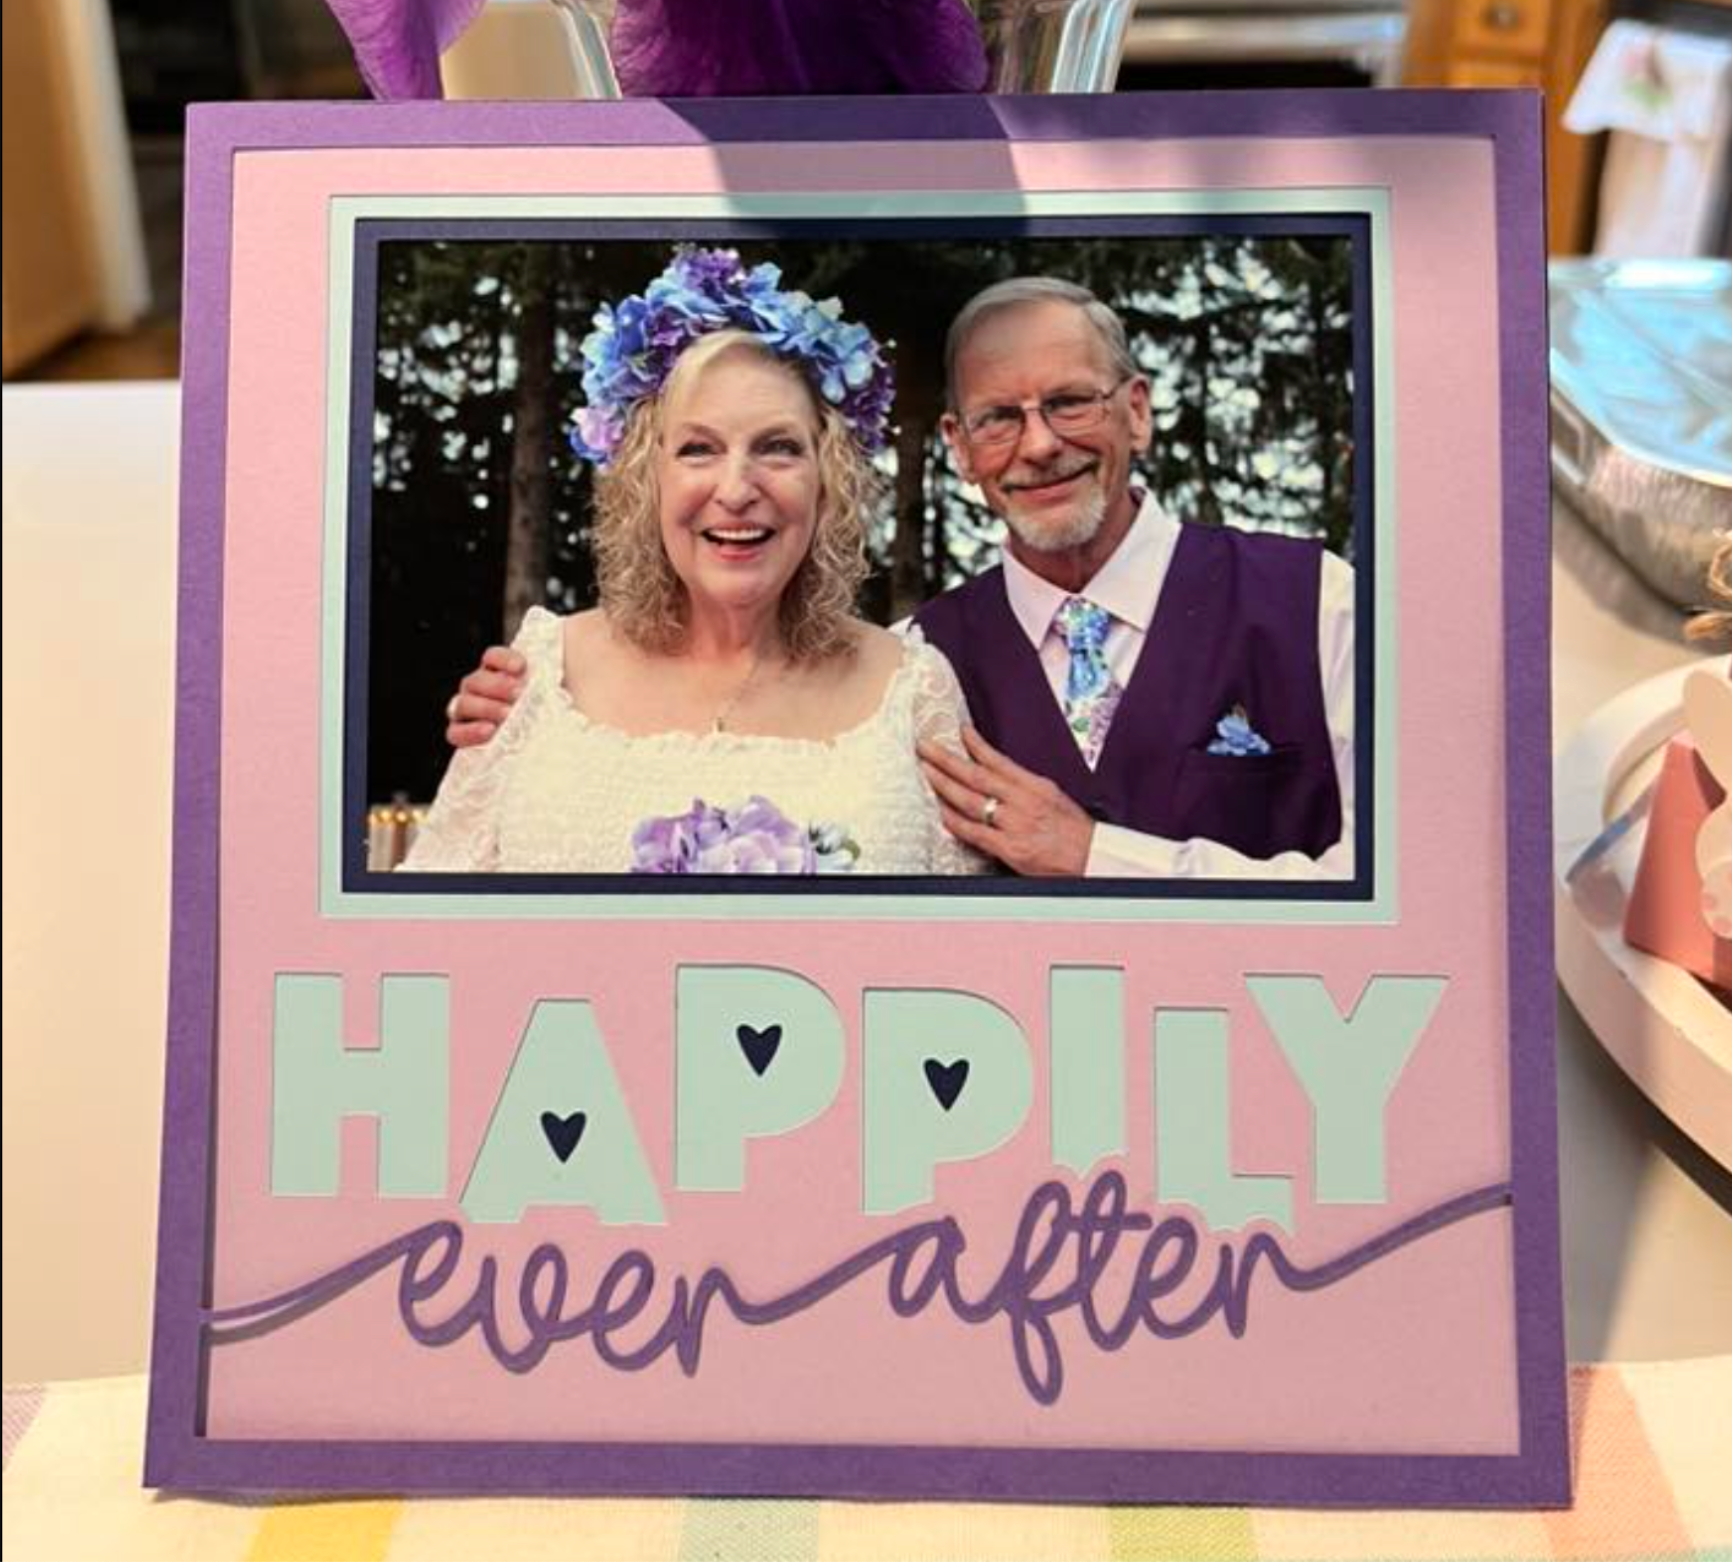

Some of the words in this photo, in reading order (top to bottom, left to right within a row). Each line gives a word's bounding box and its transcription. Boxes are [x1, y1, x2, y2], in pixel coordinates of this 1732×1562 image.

[269, 963, 1450, 1237] HAPPILY
[399, 1219, 768, 1377] ever
[888, 1169, 1322, 1406] after
